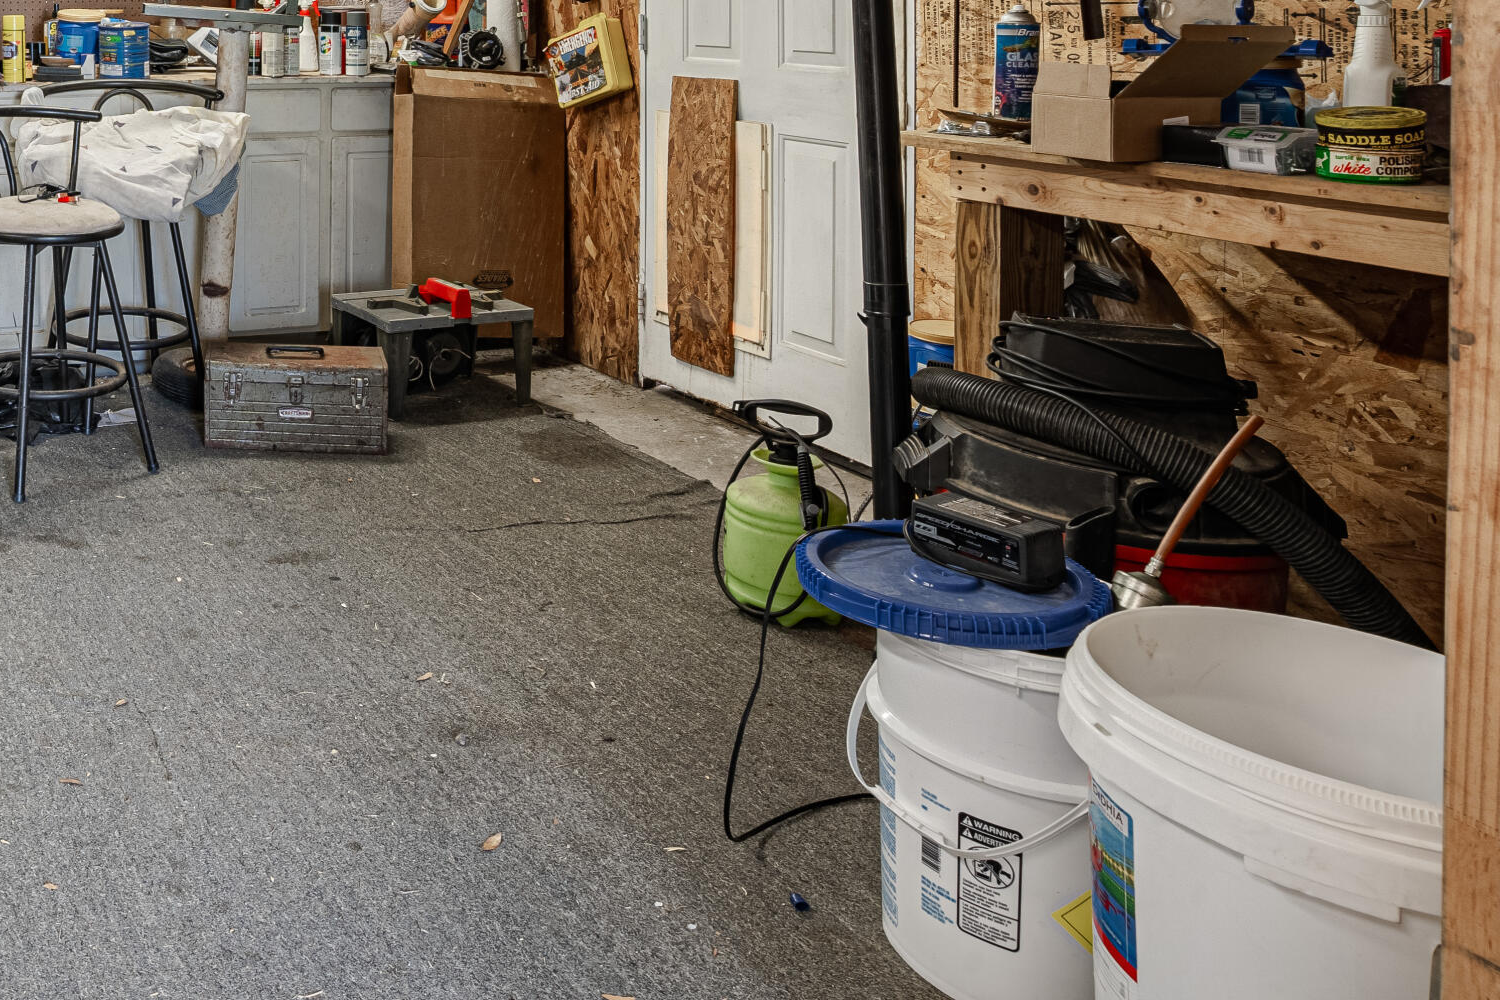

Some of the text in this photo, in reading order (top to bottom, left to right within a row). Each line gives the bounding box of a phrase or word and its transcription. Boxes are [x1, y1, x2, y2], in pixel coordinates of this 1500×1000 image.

[1328, 133, 1391, 146] SADDLE
[1332, 161, 1372, 175] white
[973, 819, 1020, 841] WARNING
